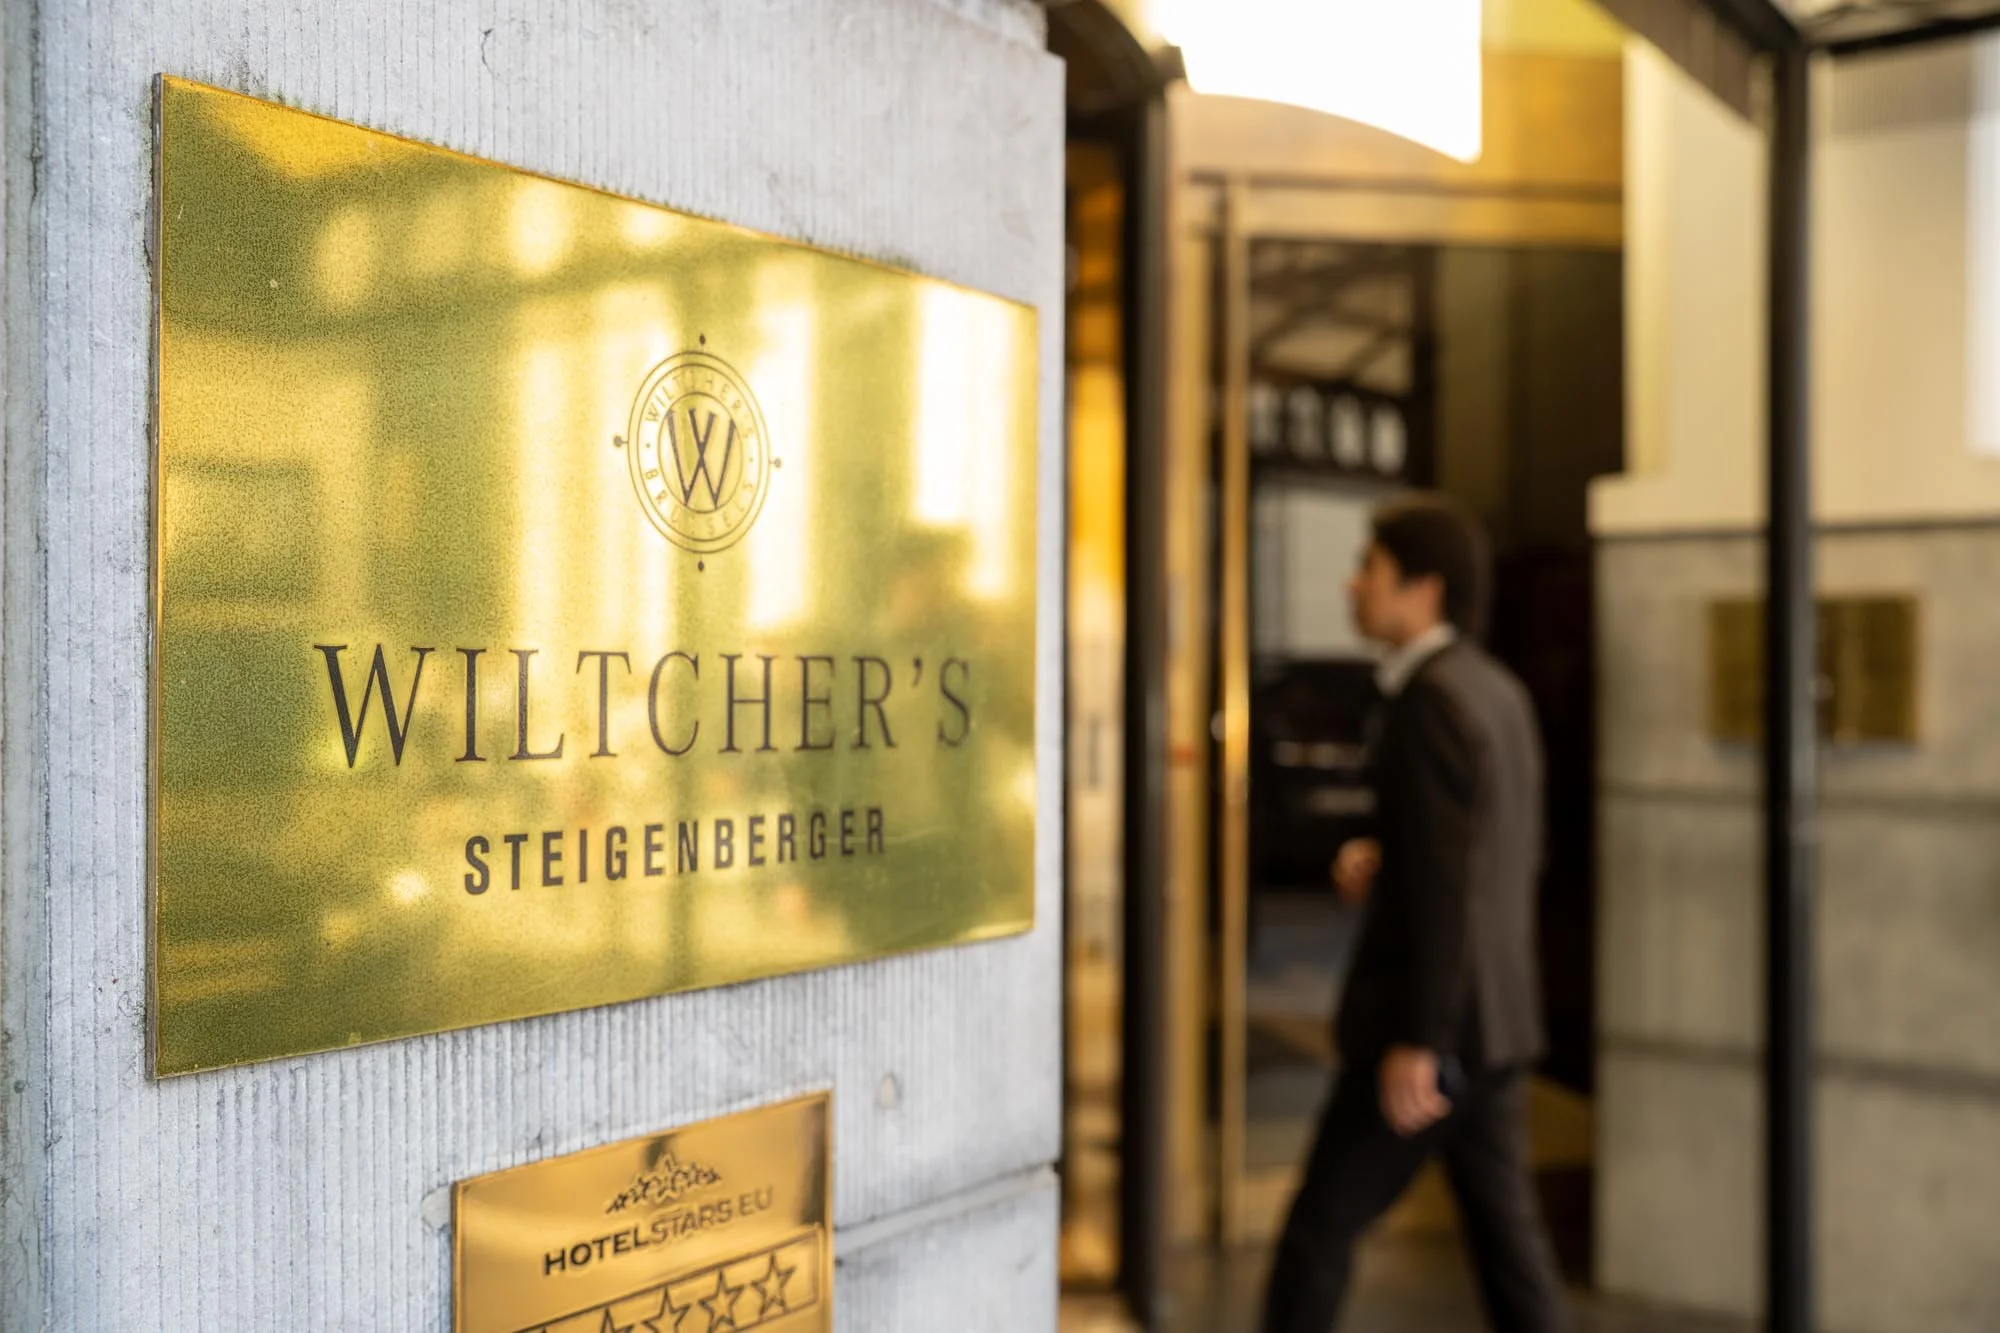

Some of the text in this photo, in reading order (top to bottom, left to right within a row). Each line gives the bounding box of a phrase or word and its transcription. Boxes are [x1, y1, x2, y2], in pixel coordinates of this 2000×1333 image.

[645, 369, 756, 438] WILTHERS
[313, 643, 972, 769] WILTCHER'S
[463, 806, 886, 897] STEIGENBERGER
